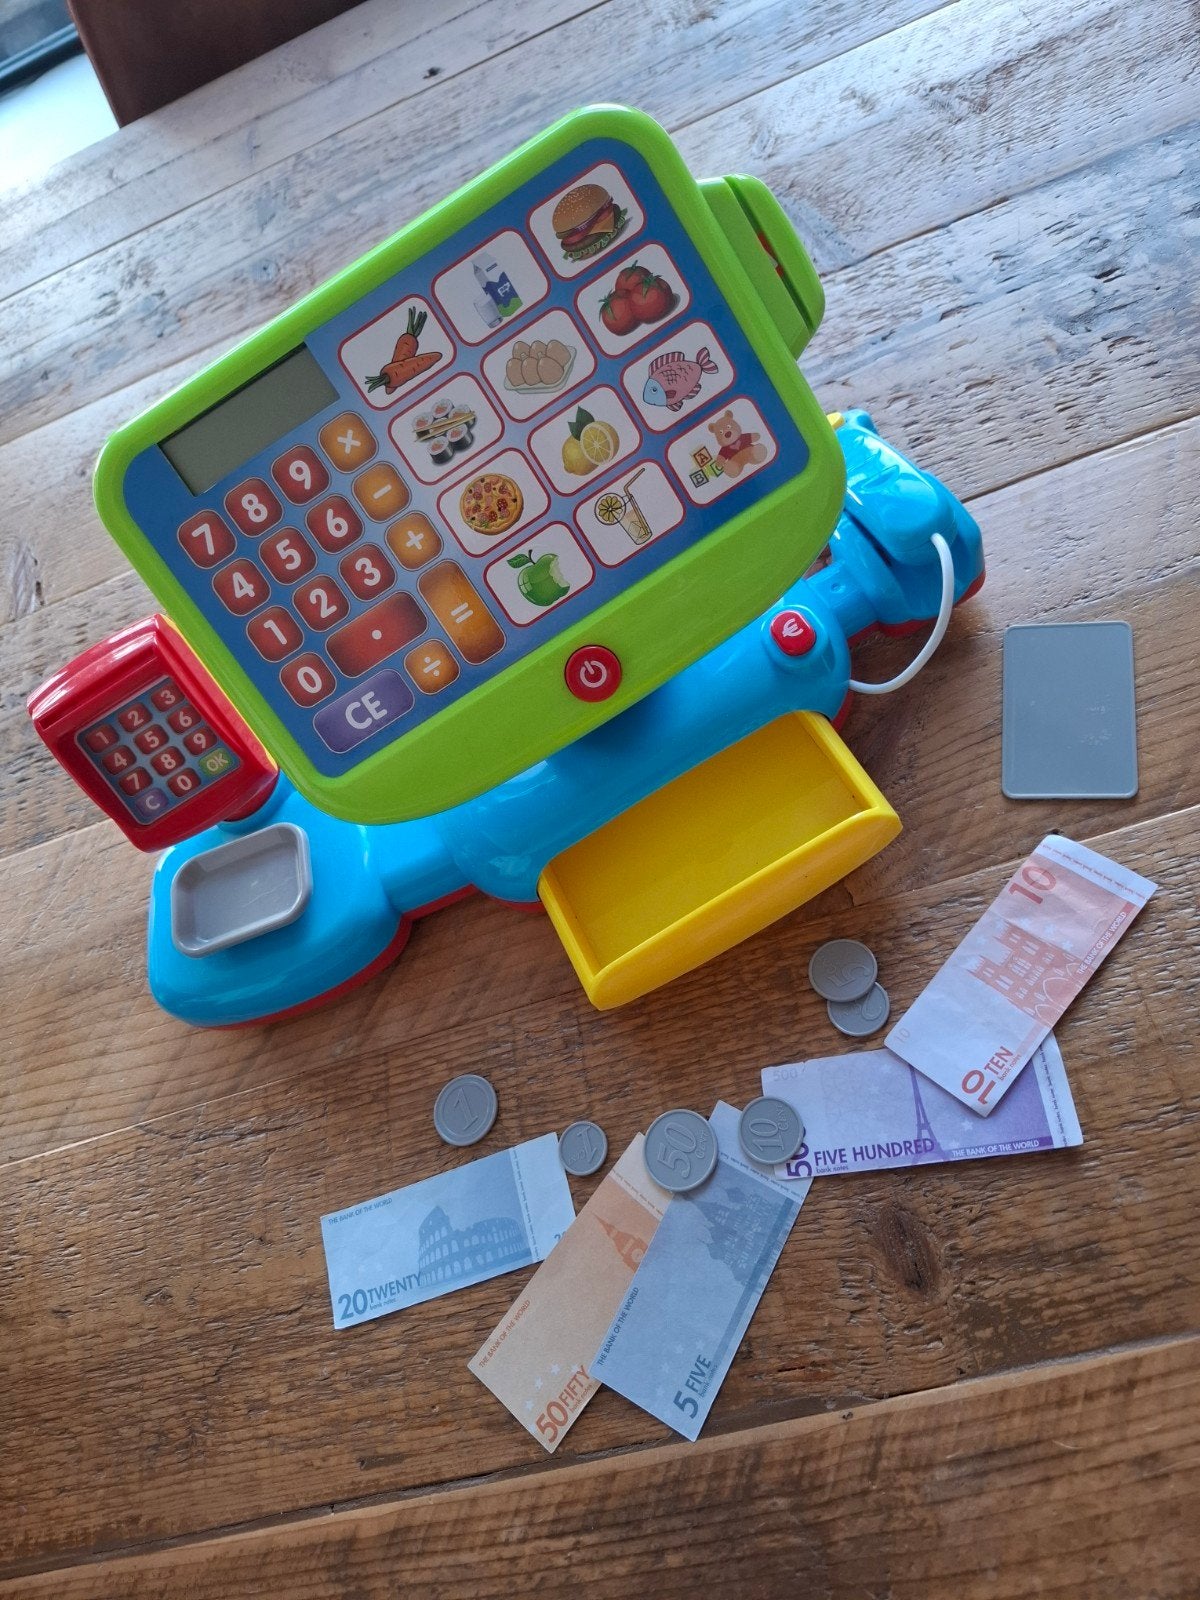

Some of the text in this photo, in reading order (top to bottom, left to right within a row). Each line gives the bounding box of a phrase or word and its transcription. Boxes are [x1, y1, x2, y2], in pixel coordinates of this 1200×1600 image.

[698, 452, 709, 464] A
[693, 473, 705, 485] B
[191, 523, 215, 555] 7
[241, 493, 268, 523] 8
[289, 460, 312, 490] 9
[232, 572, 255, 600] 4
[276, 538, 301, 570] 5
[326, 508, 348, 538] 6
[263, 620, 287, 645] 1
[309, 588, 337, 619] 2
[355, 557, 381, 586] 3
[297, 665, 323, 694] 0
[96, 689, 176, 744] 1 2 3
[345, 691, 388, 729] CE
[113, 711, 193, 768] 4 5 6
[126, 733, 207, 790] 7 8 9
[146, 753, 229, 810] C 0 OK
[1009, 865, 1056, 904] 10
[1108, 912, 1127, 932] WORLD
[984, 1046, 1013, 1075] TEN
[962, 1070, 996, 1105] 10
[454, 1087, 478, 1131] 1
[577, 1125, 597, 1164] 1
[657, 1121, 697, 1179] 50
[749, 1118, 784, 1151] 10
[814, 1138, 935, 1167] FIVE HUNDRED
[952, 1140, 1040, 1157] THE BANK OF THE WORLD
[816, 1166, 832, 1174] bank
[374, 1197, 393, 1209] WORLD
[338, 1271, 421, 1320] 20 TWENTY
[514, 1299, 531, 1320] WORLD
[603, 1334, 617, 1353] BANK
[624, 1287, 639, 1311] WORLD
[536, 1365, 589, 1443] 50 FIFTY
[673, 1354, 711, 1419] 5 FIVE
